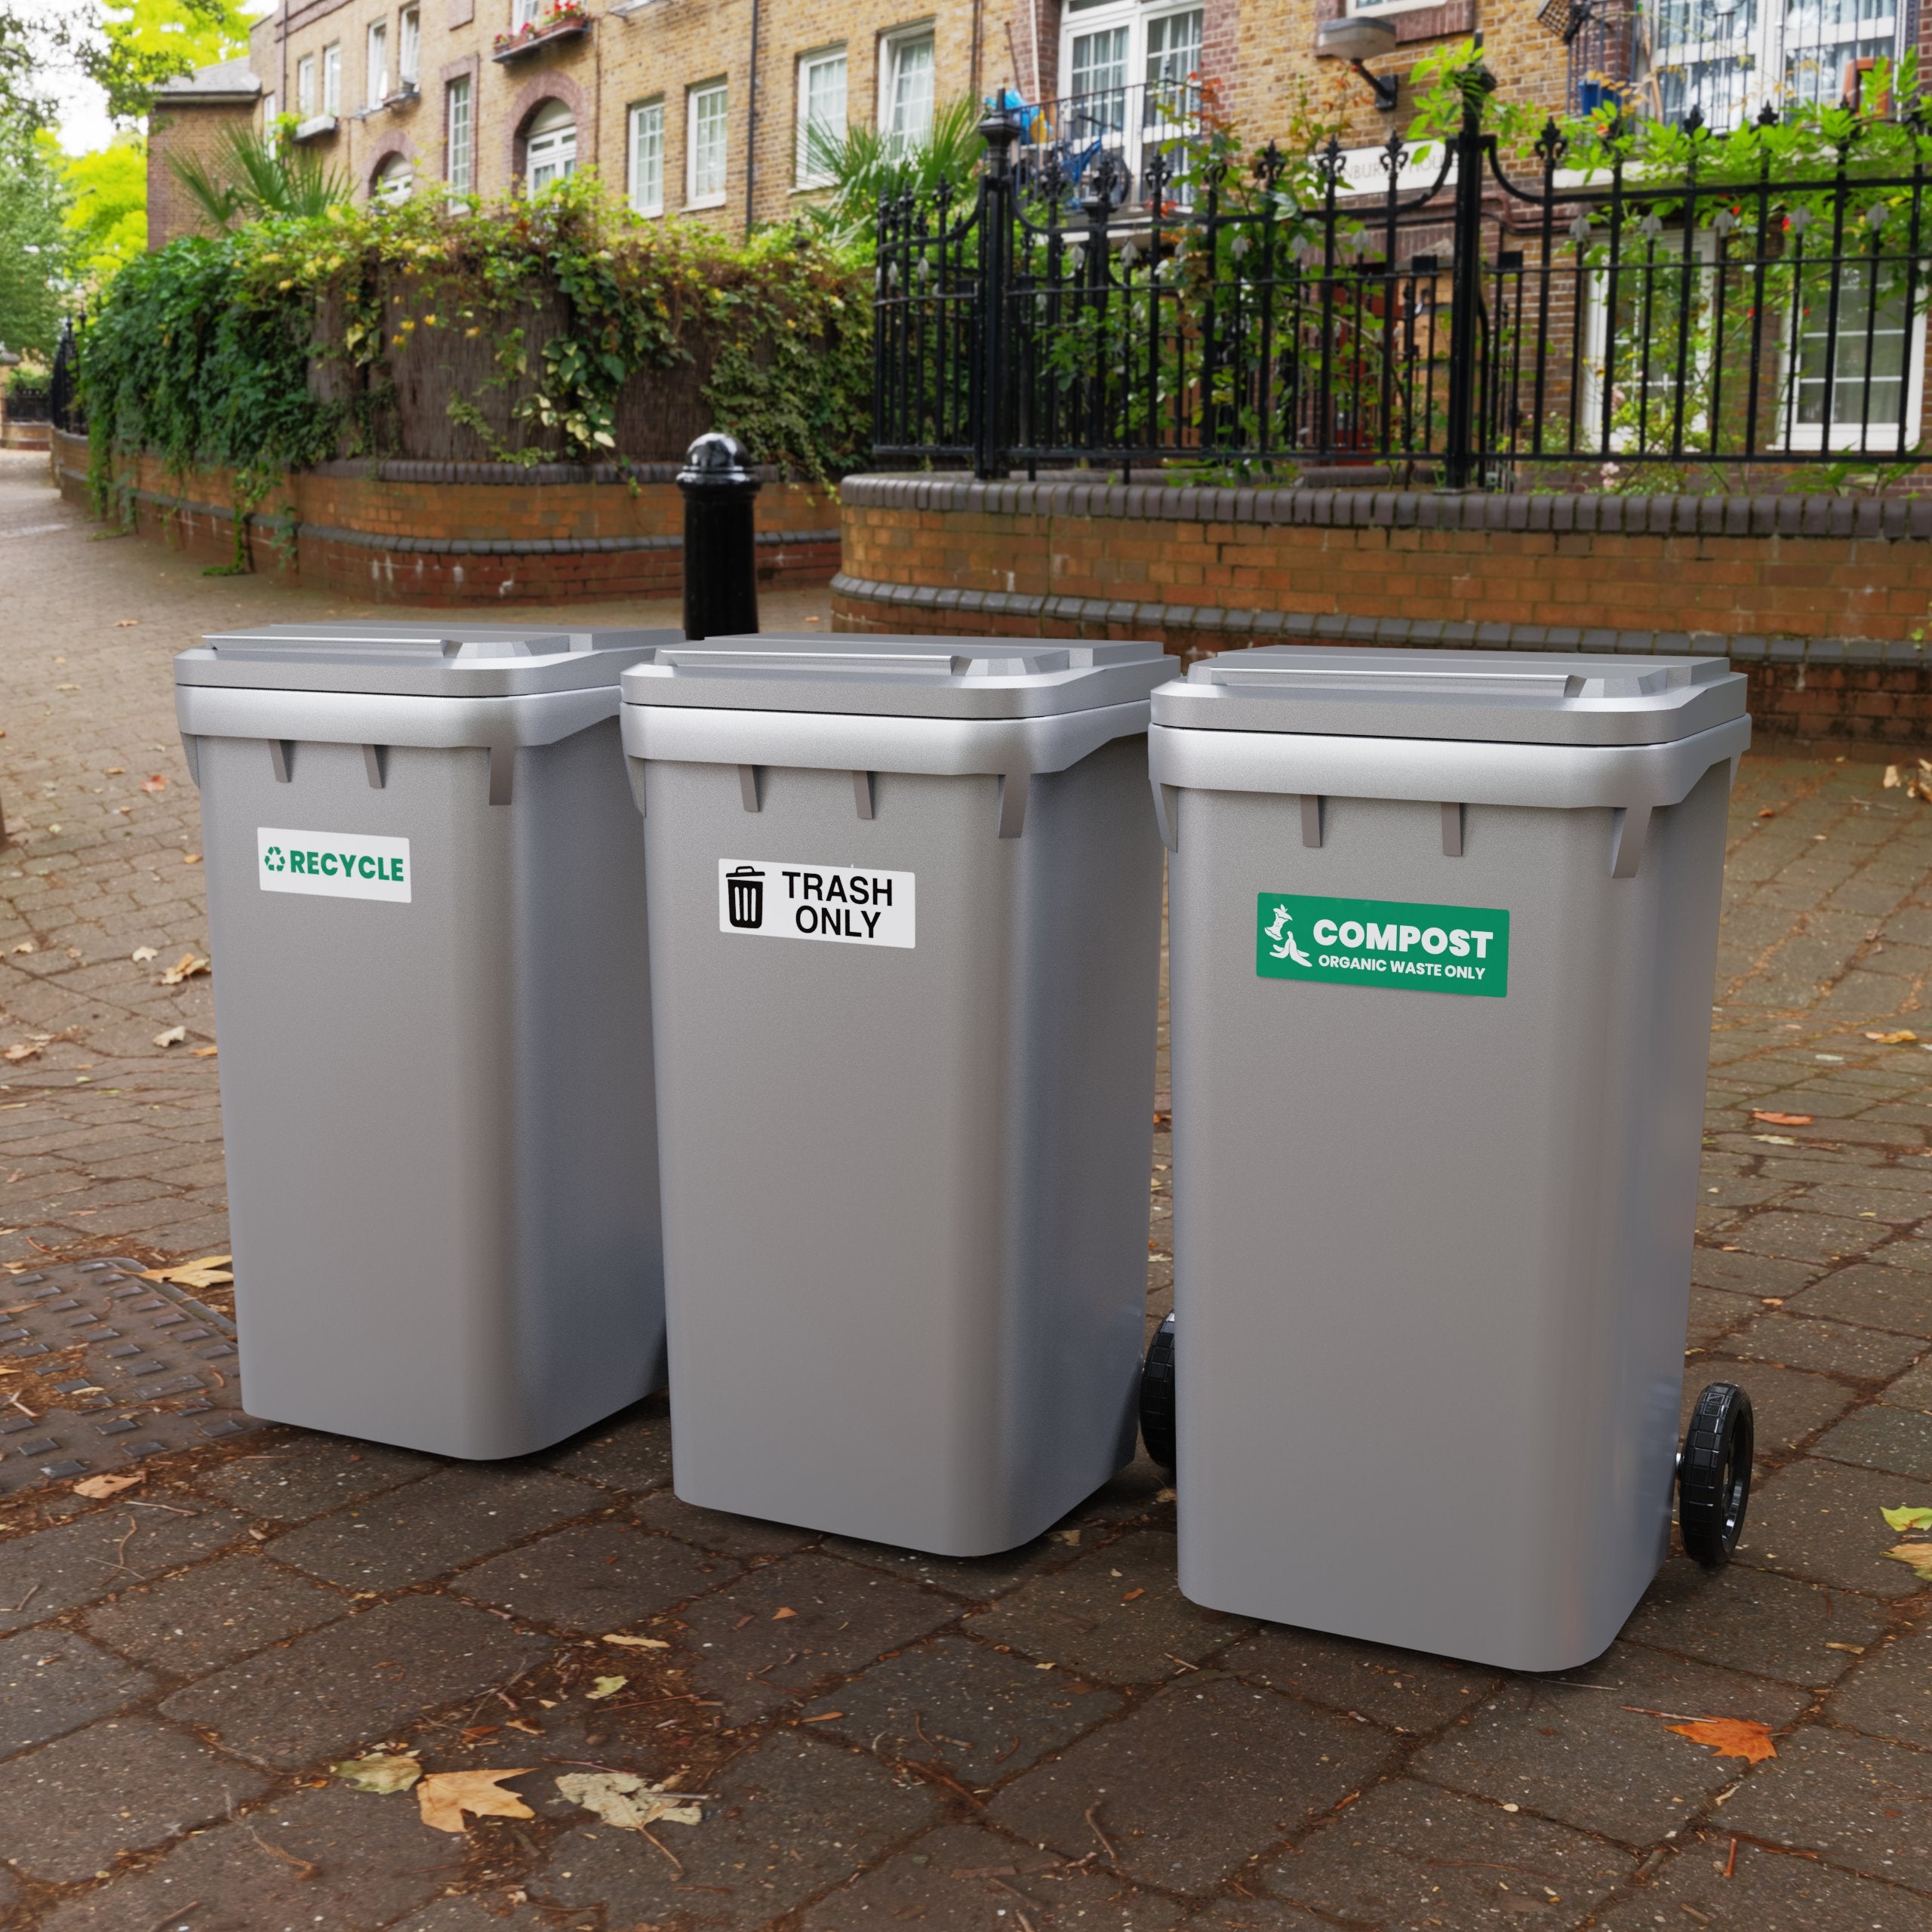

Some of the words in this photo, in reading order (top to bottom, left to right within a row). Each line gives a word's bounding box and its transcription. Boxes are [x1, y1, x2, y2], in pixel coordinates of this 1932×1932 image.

[290, 850, 405, 882] RECYCLE
[782, 871, 893, 906] TRASH
[795, 905, 881, 938] ONLY
[1313, 918, 1494, 958] COMPOST
[1318, 954, 1387, 972] ORGANIC
[1389, 960, 1442, 977] WASTE
[1444, 965, 1486, 980] ONLY
